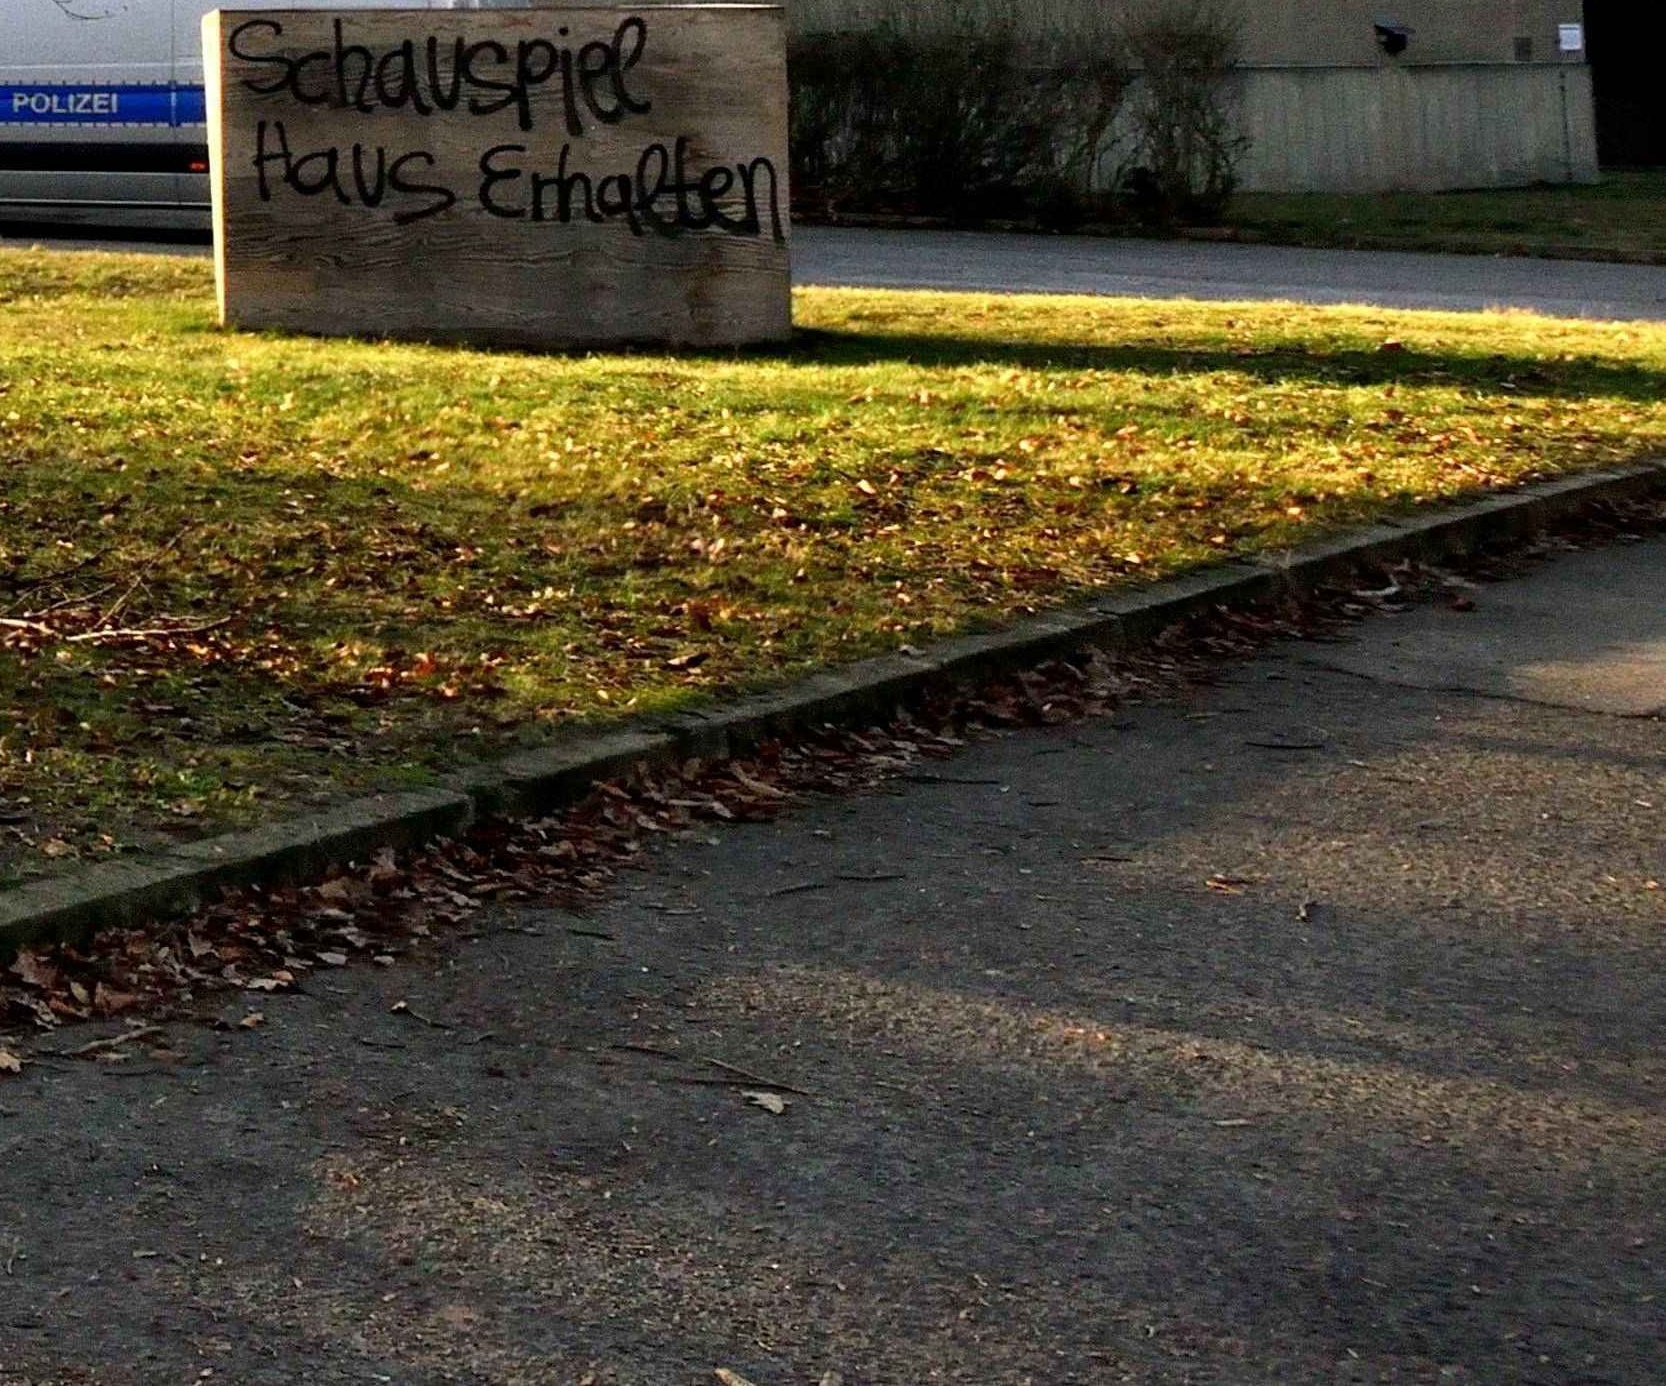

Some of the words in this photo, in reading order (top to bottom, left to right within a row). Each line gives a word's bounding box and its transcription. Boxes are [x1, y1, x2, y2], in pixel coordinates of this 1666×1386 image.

[12, 92, 120, 114] POLIZEI
[229, 17, 652, 135] Schauspiel
[251, 121, 457, 224] Haus
[478, 136, 787, 242] Erhalten
